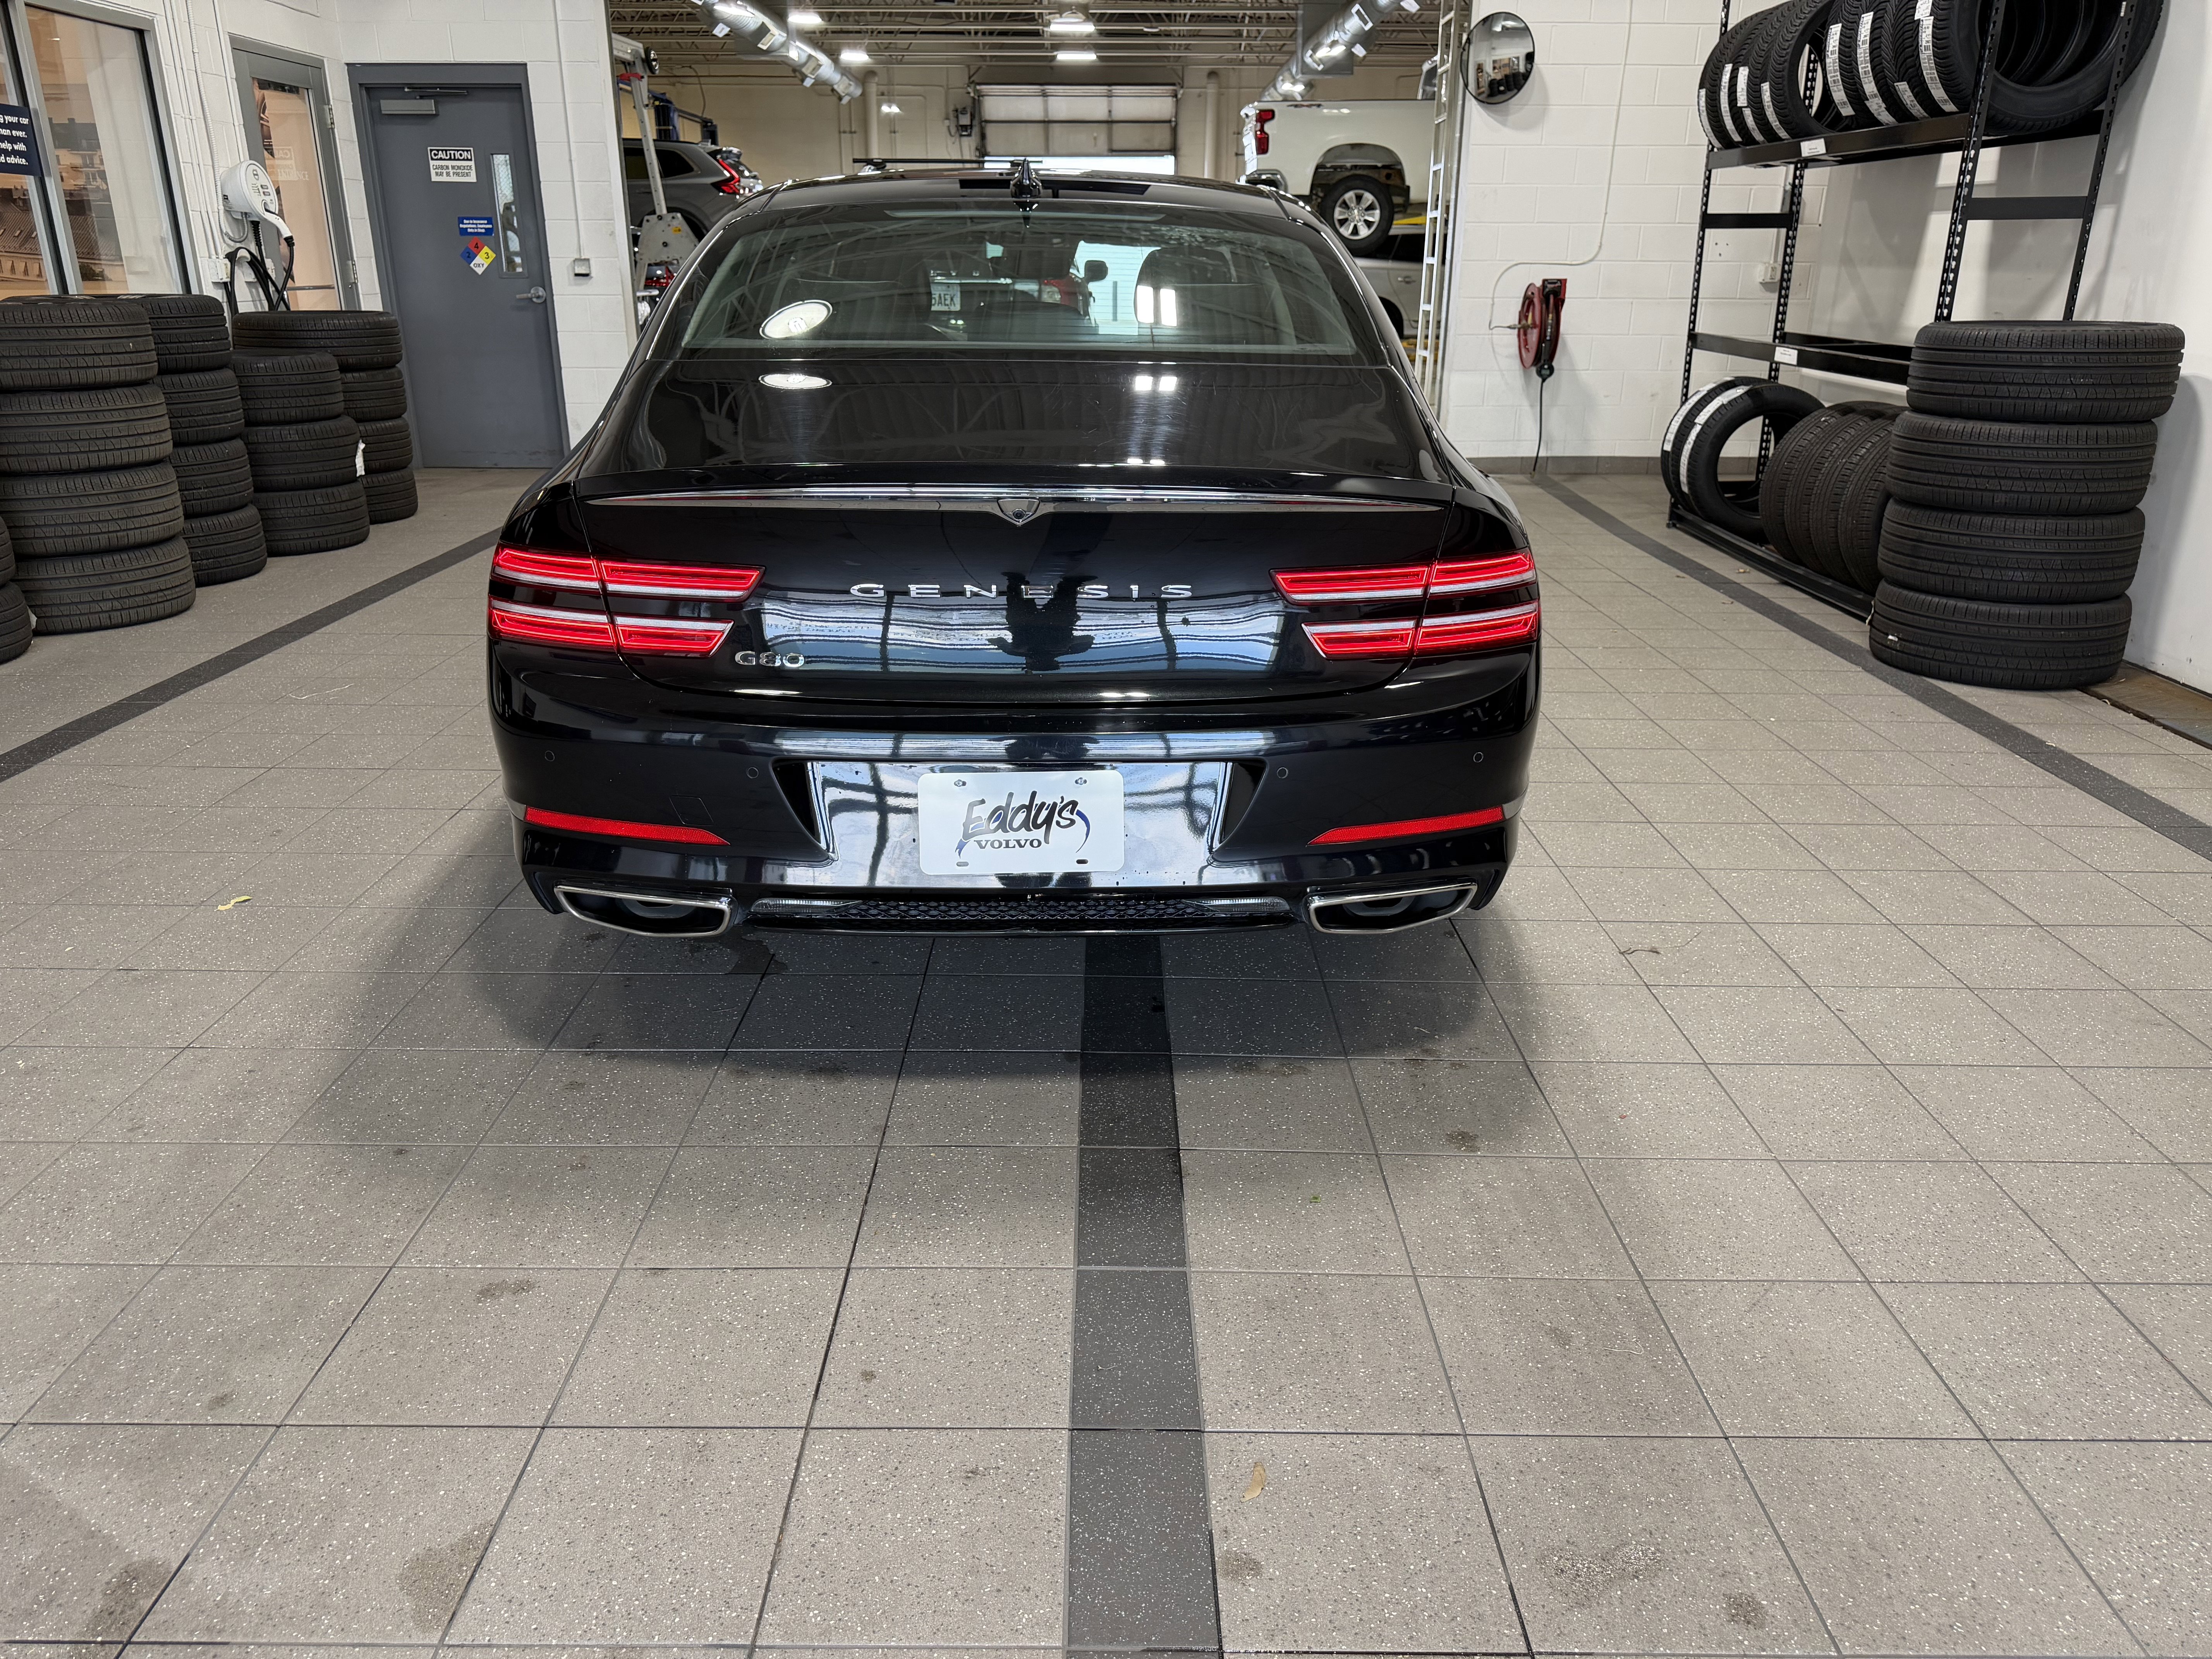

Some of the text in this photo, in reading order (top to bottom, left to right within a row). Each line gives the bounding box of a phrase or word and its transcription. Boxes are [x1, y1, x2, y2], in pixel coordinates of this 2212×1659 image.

[4, 115, 18, 124] your
[13, 142, 27, 151] with
[431, 150, 471, 159] CAUTION
[6, 155, 28, 165] advice.
[850, 584, 1192, 599] GENESIS
[735, 651, 805, 667] G80
[962, 790, 1079, 845] Eddy's
[974, 838, 1042, 849] VOLVO
